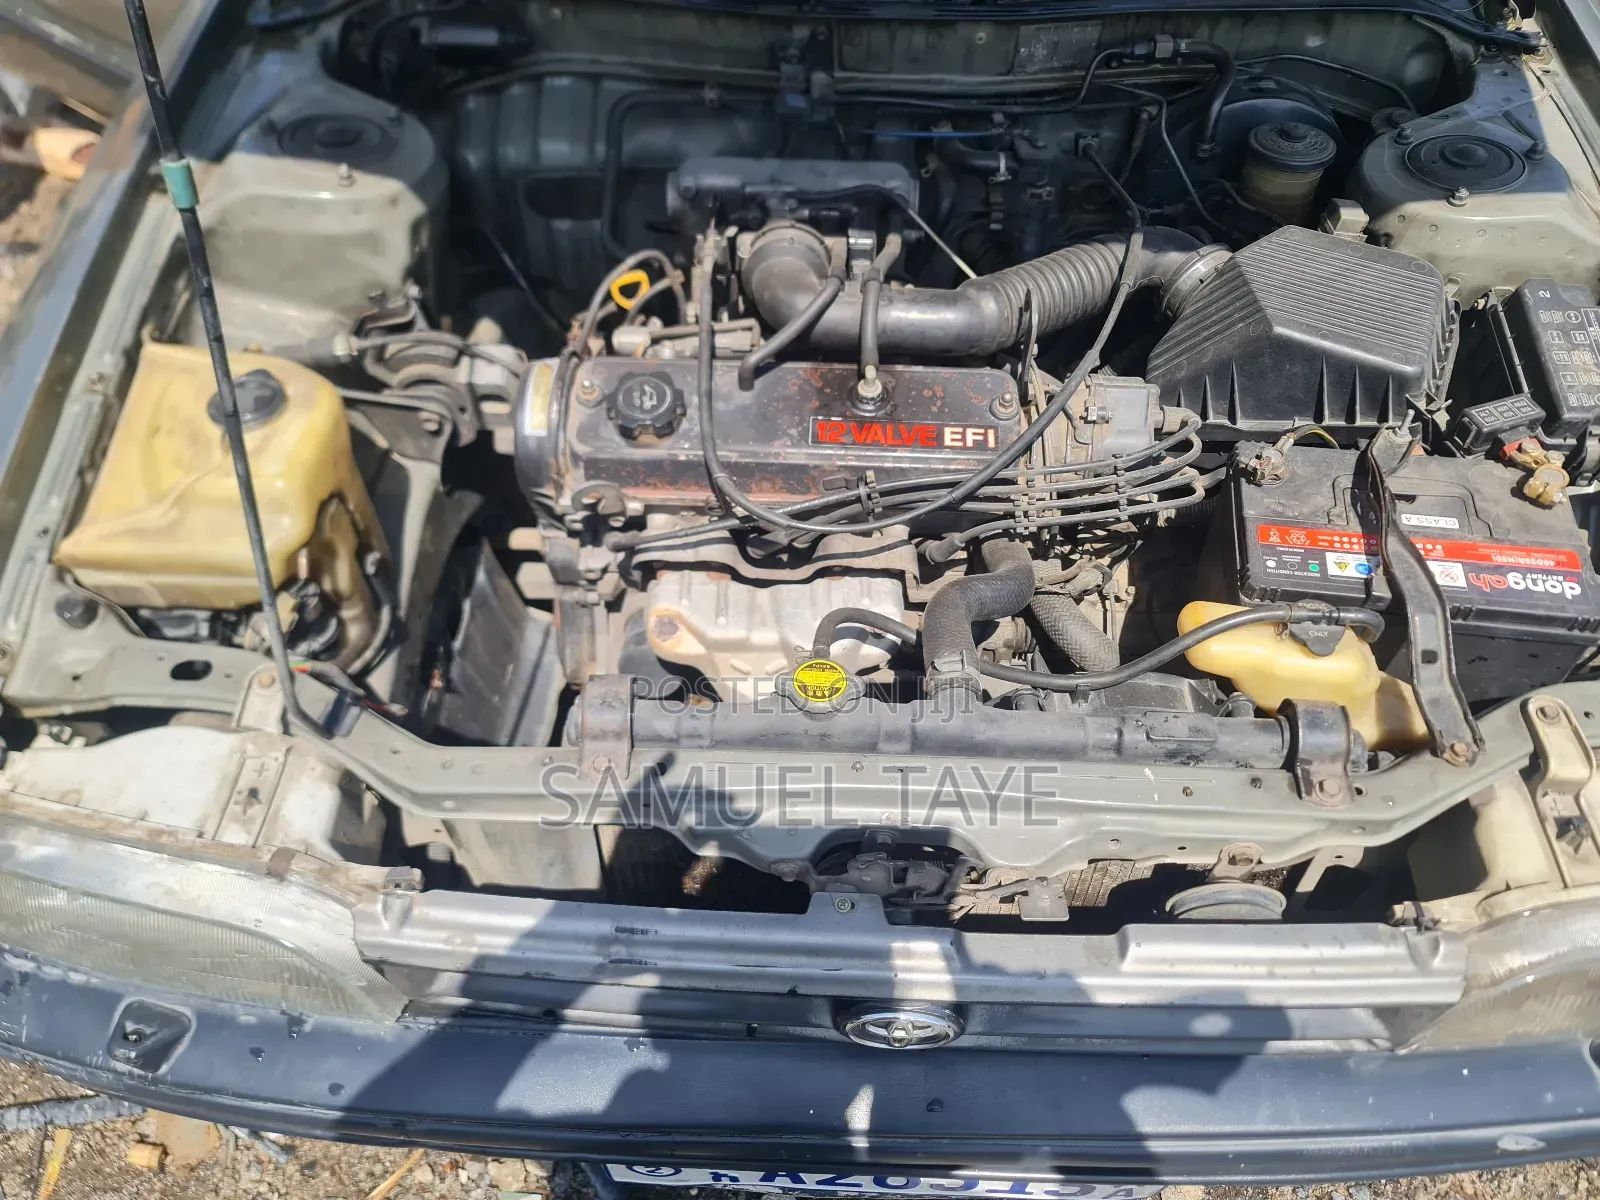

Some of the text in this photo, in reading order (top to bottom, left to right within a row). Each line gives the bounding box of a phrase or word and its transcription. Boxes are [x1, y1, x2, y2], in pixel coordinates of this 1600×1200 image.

[815, 421, 996, 448] 12 VALVE EFI
[1402, 515, 1457, 527] CLASS A
[1468, 572, 1582, 600] dongah
[1525, 573, 1563, 582] BATTERY
